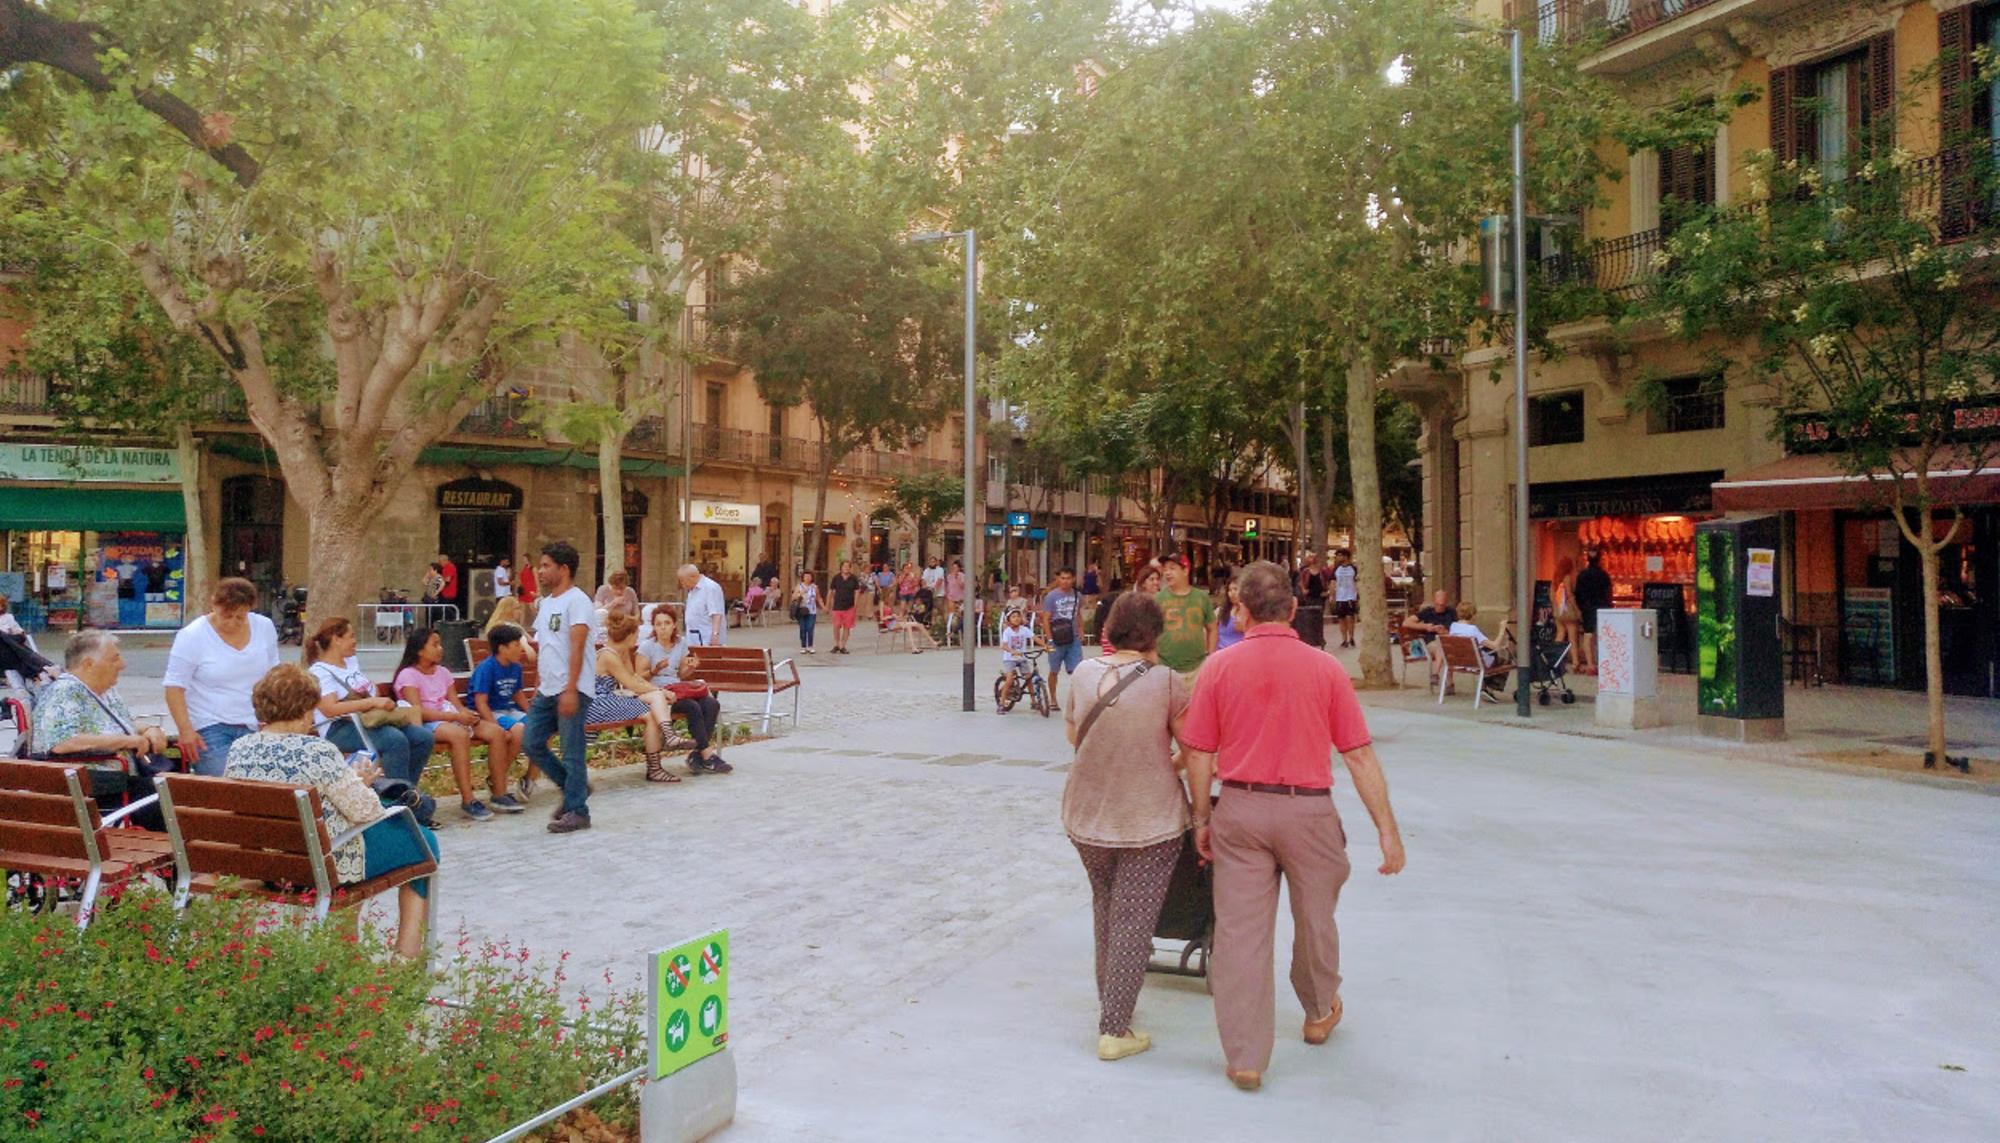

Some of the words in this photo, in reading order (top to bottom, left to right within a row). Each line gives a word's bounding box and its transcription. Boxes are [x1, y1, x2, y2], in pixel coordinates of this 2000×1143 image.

[22, 447, 37, 462] LA
[86, 449, 100, 464] DE
[104, 450, 119, 464] LA
[122, 450, 171, 466] NATURA
[442, 490, 513, 507] RESTAURANT
[1245, 519, 1257, 532] P
